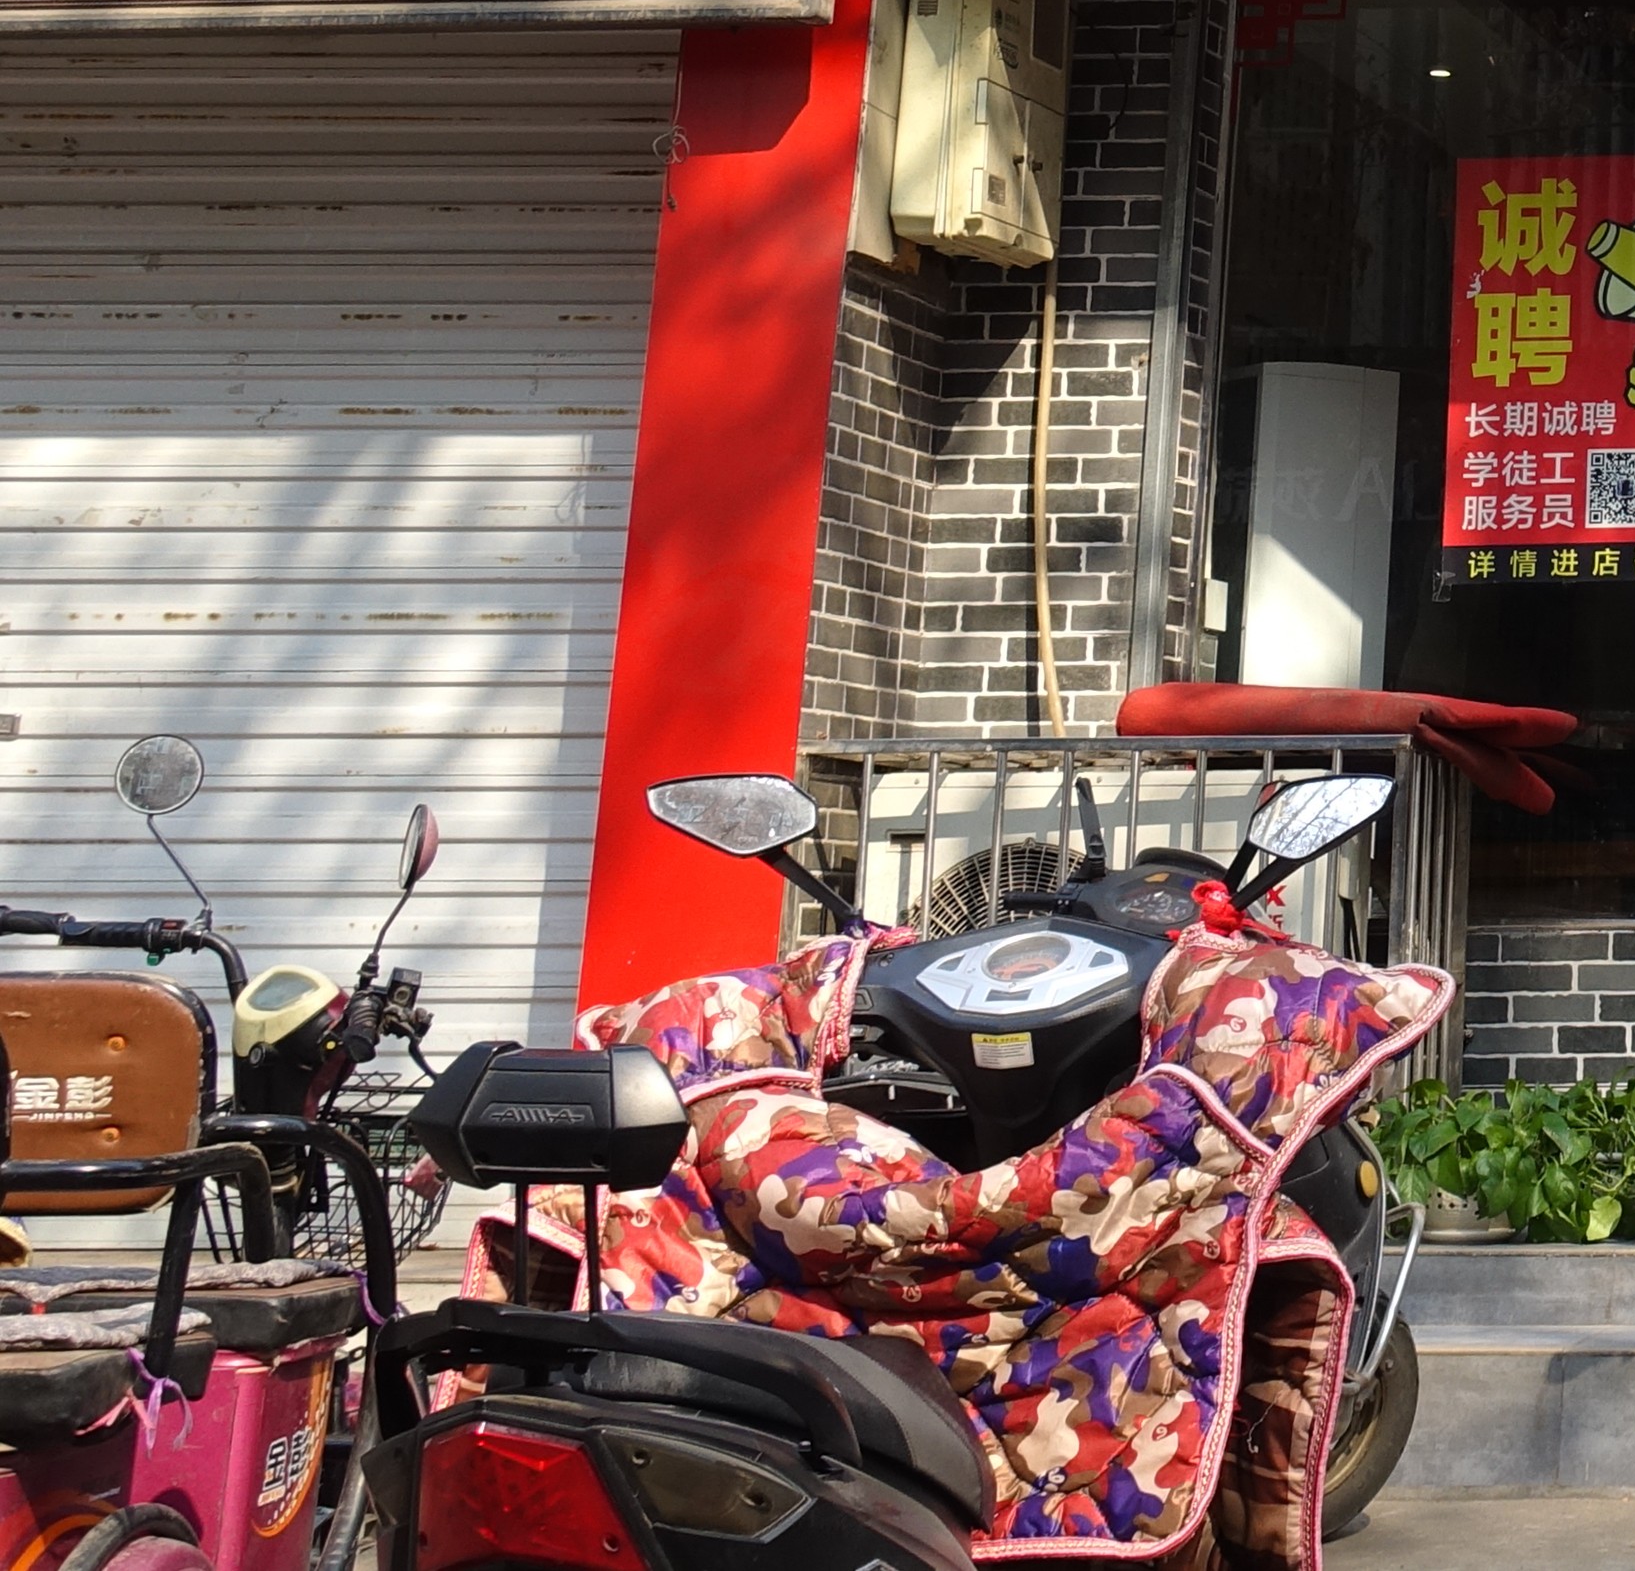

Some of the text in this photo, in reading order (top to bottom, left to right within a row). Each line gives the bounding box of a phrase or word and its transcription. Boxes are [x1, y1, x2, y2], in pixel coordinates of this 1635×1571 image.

[1471, 178, 1578, 387] 诚聘
[1464, 401, 1617, 438] 长期诚聘
[1462, 450, 1576, 487] 学徒工
[1461, 493, 1576, 531] 服务员
[10, 1070, 114, 1110] 金彭
